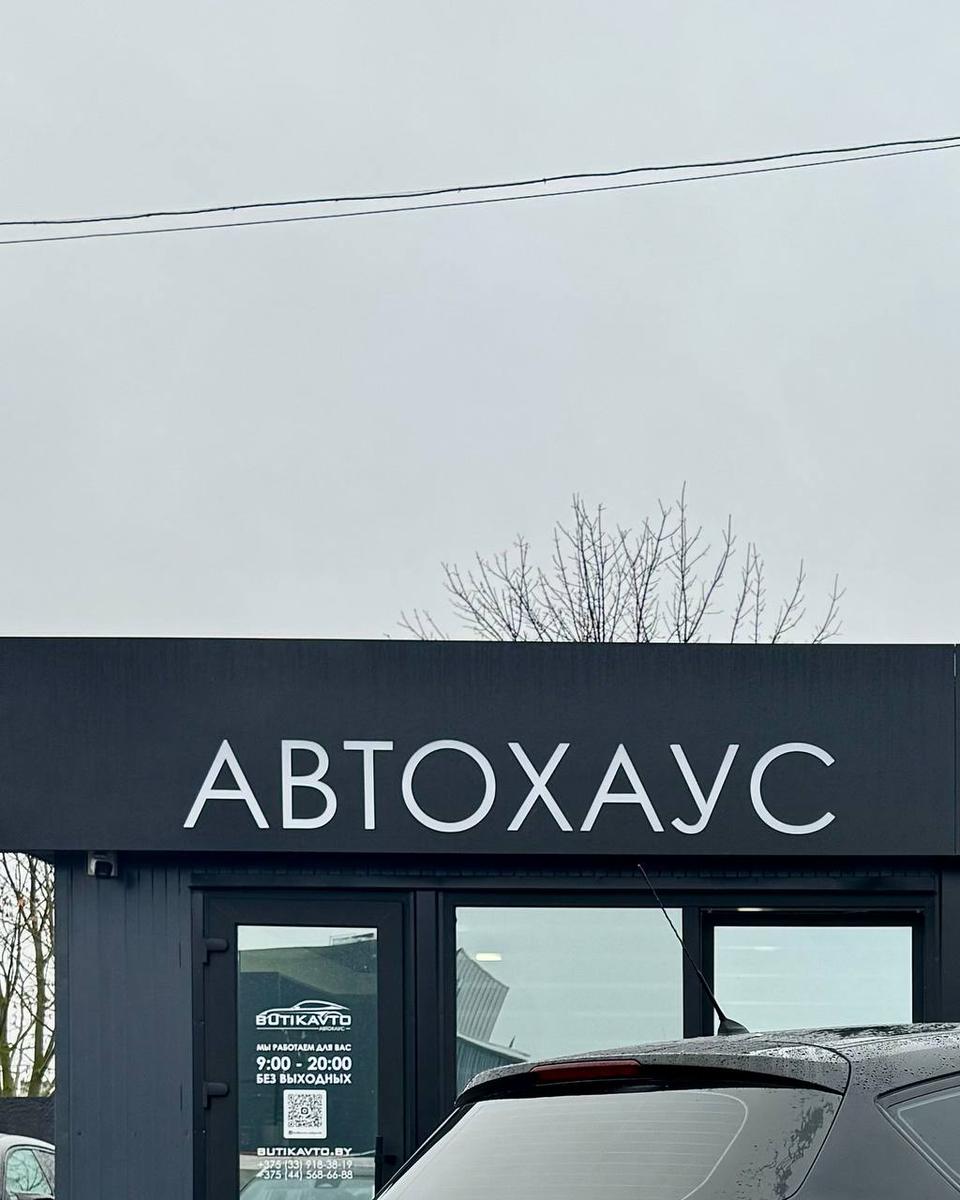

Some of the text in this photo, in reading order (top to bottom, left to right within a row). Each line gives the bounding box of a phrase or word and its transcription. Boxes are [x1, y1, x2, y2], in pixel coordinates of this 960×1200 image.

[184, 740, 835, 834] АВТОХАУС
[256, 1014, 352, 1026] BUTIKAVTO
[316, 1044, 333, 1052] ДЛЯ
[256, 1057, 291, 1071] 9:00
[308, 1057, 352, 1071] 20:00
[256, 1073, 352, 1085] БЕЗ ВЫХОДНЫХ
[257, 1148, 353, 1156] BUTIKAVTO.BY
[285, 1160, 303, 1170] (33)
[305, 1160, 353, 1169] 918-38-19
[256, 1170, 353, 1180] +375 (44) 568-66-88
